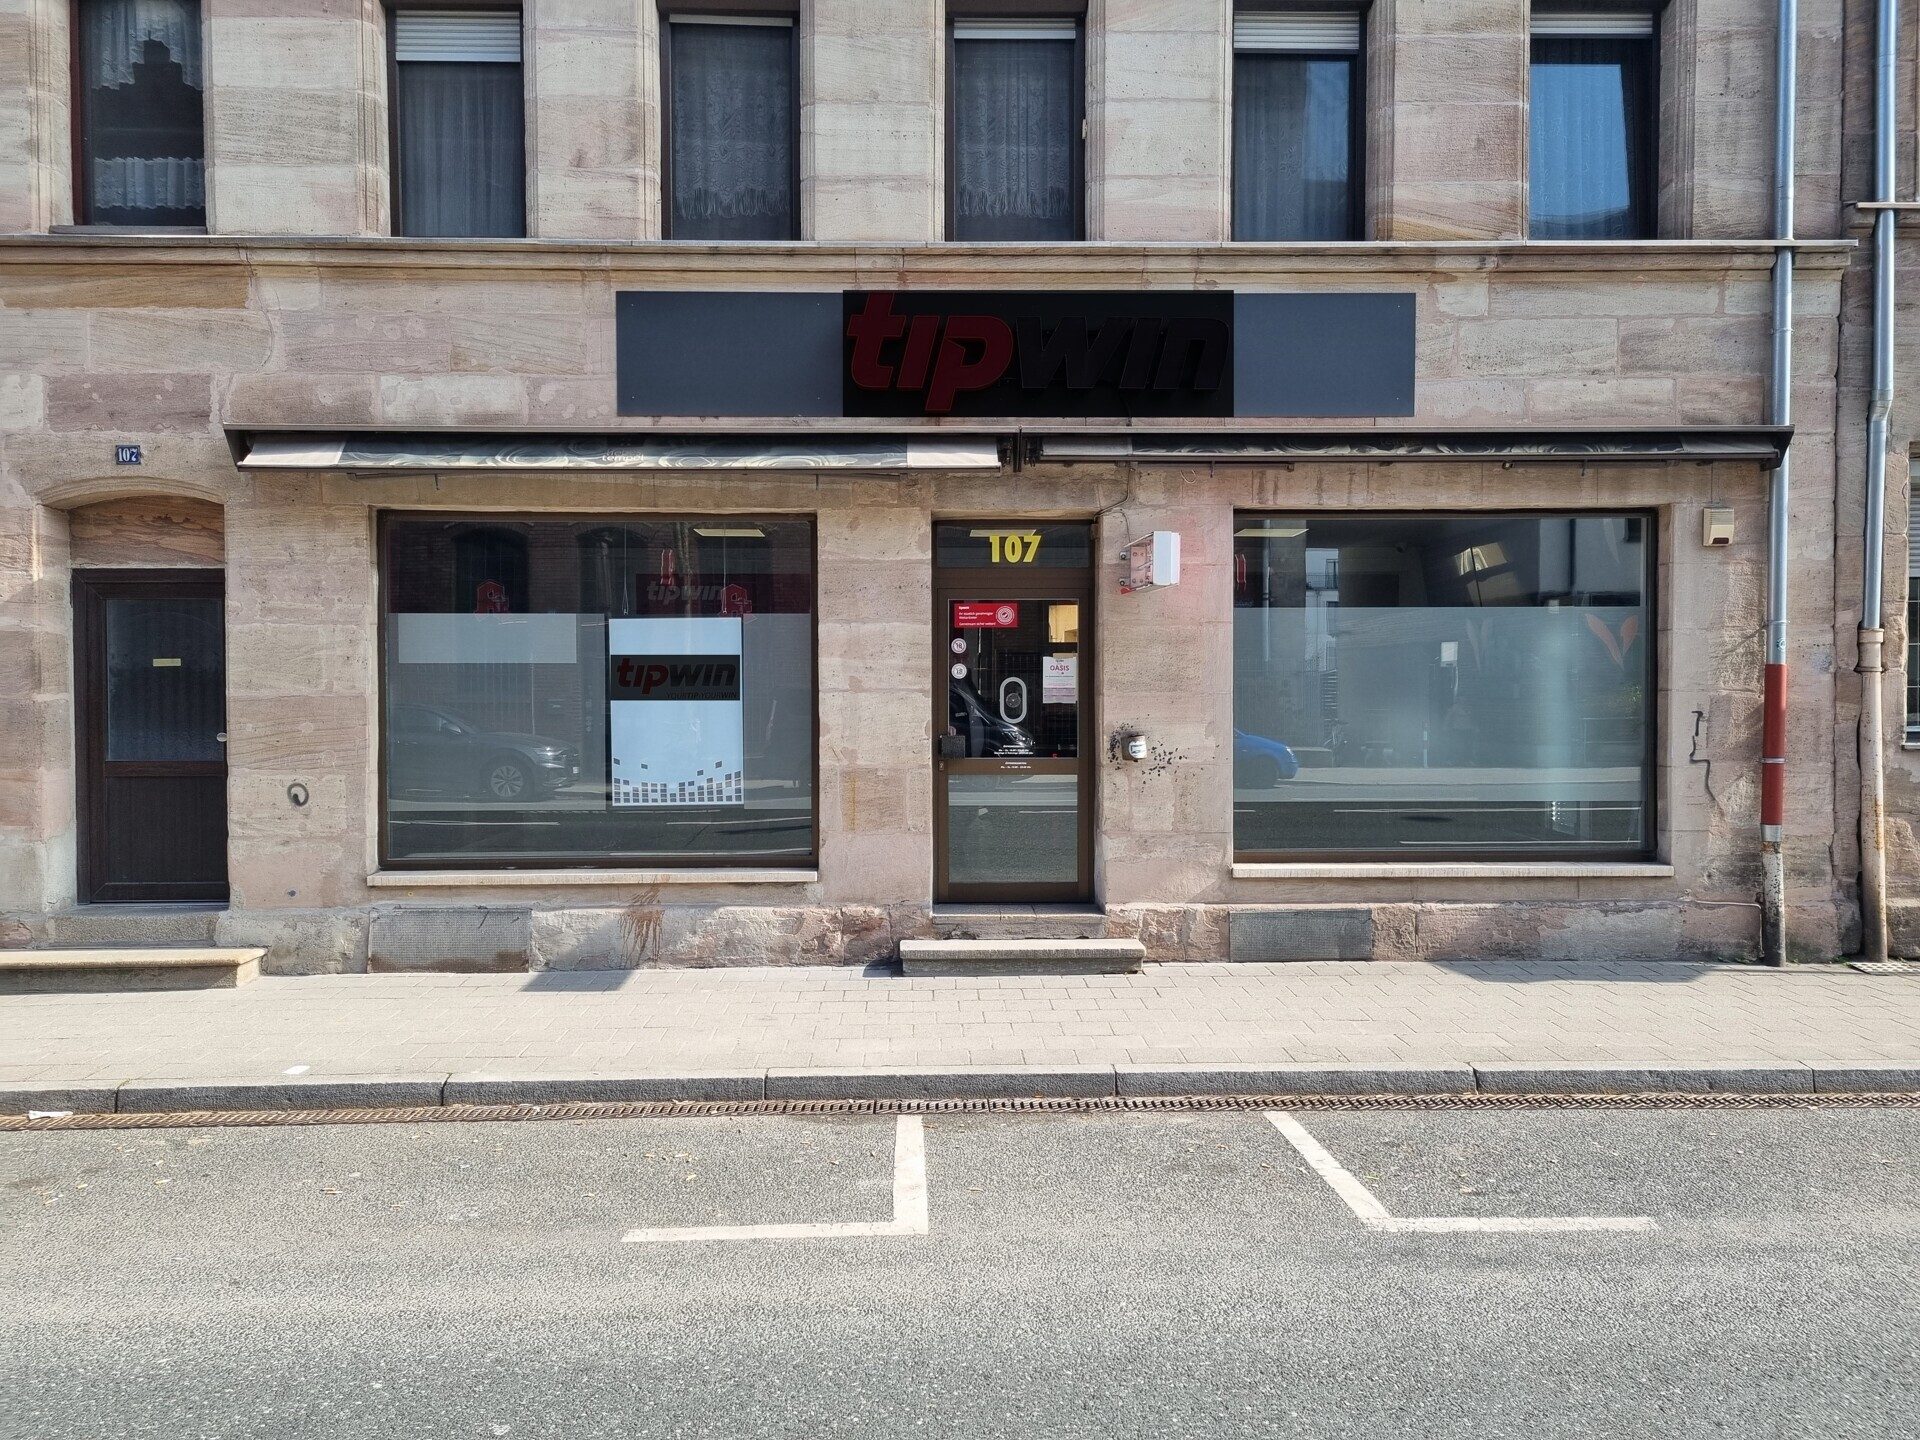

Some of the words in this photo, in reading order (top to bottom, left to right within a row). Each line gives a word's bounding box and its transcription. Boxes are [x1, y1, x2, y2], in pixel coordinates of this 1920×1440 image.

[846, 291, 1230, 412] tipwin
[118, 448, 138, 462] 107
[990, 535, 1041, 563] 107
[617, 658, 737, 694] tipwin
[1049, 664, 1070, 672] OASIS
